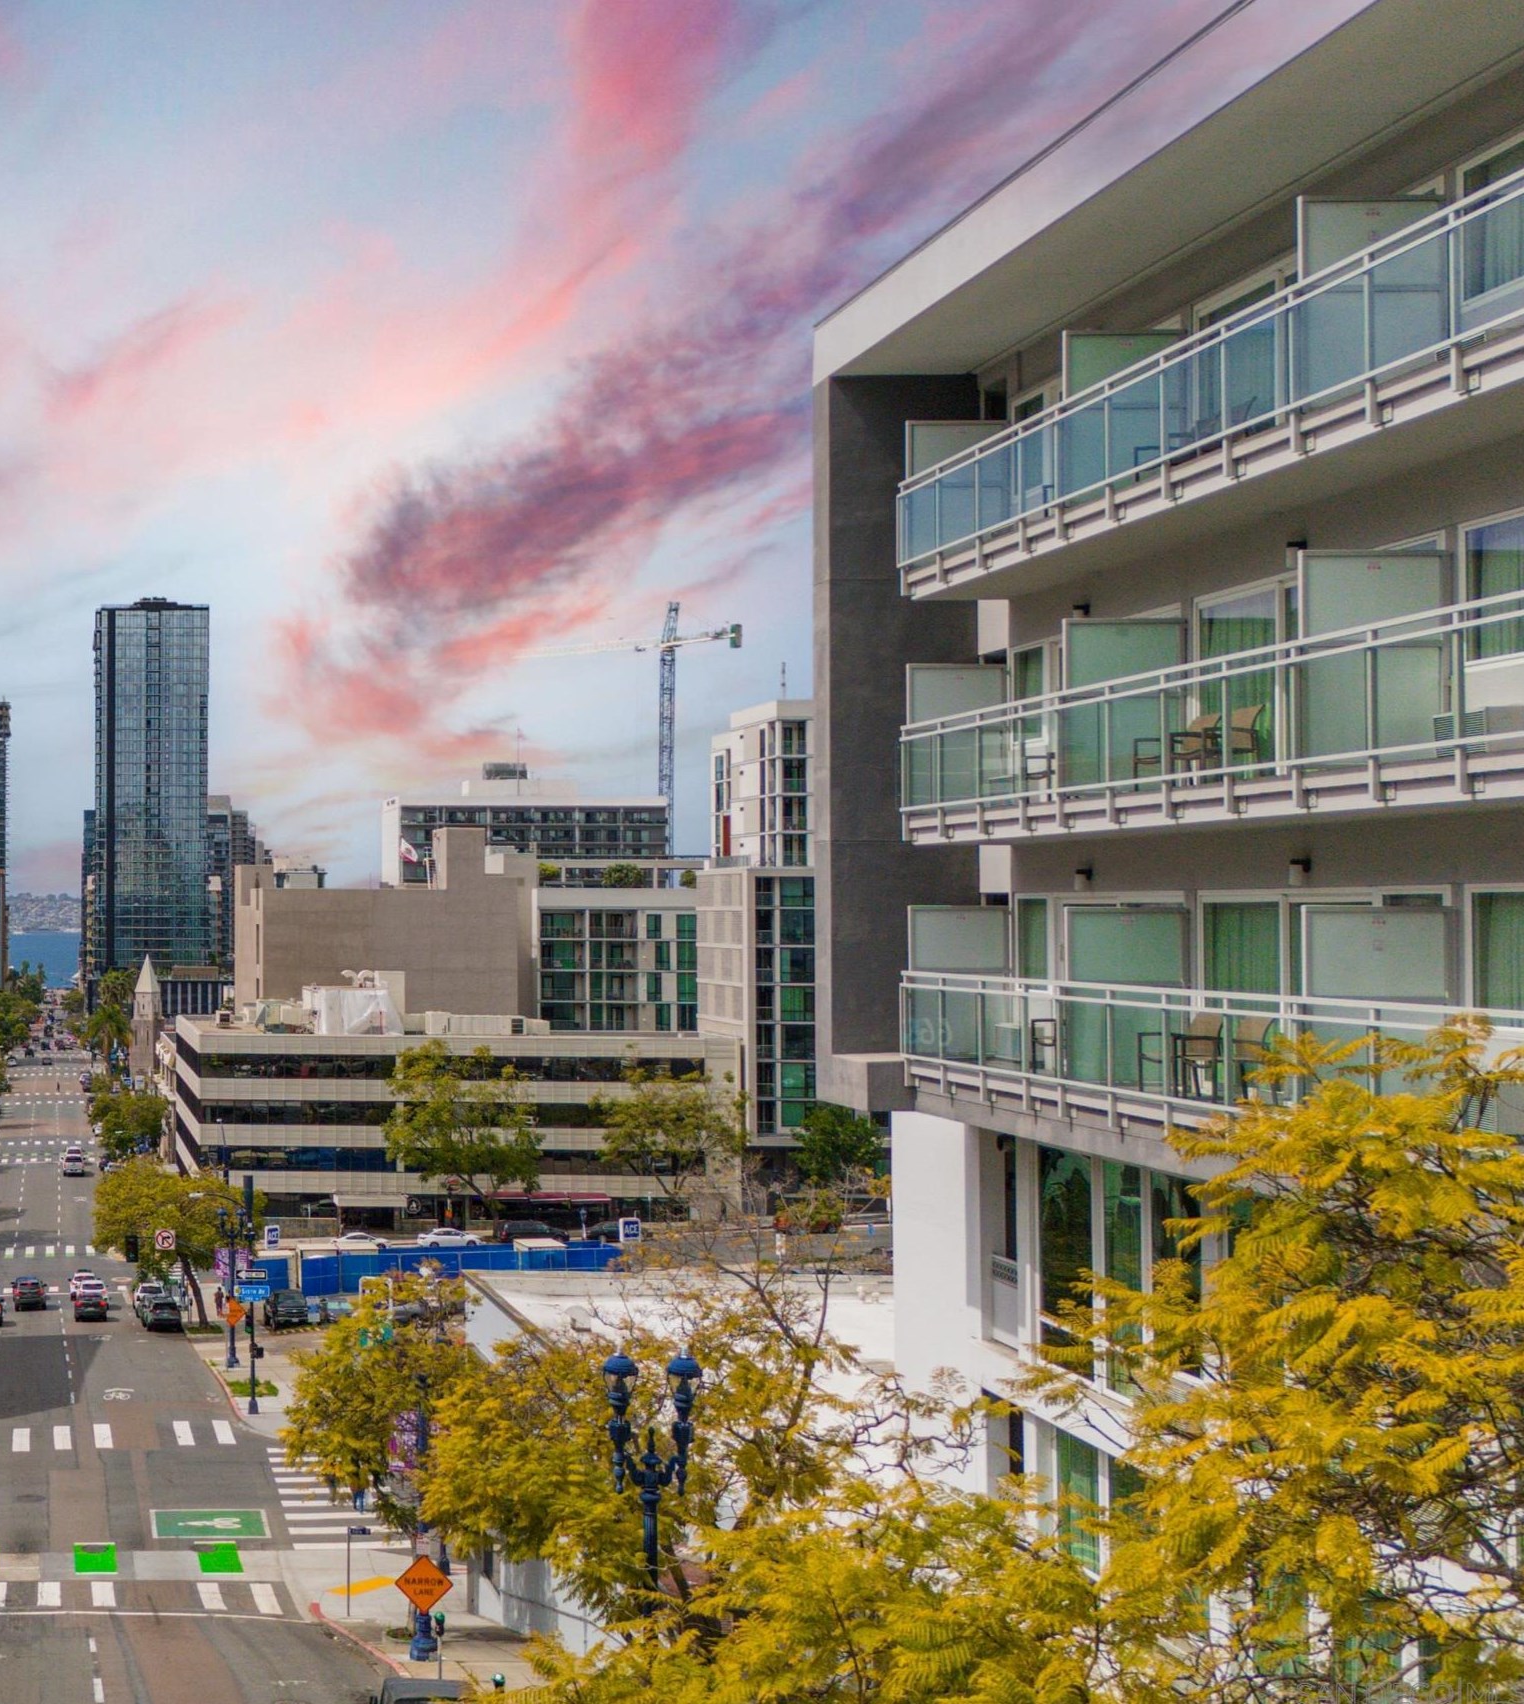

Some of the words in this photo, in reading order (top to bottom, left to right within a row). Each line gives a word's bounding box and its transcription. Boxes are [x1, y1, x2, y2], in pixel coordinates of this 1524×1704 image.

[625, 1224, 639, 1235] ACE
[404, 1577, 443, 1586] NARROW
[413, 1588, 434, 1596] LANE
